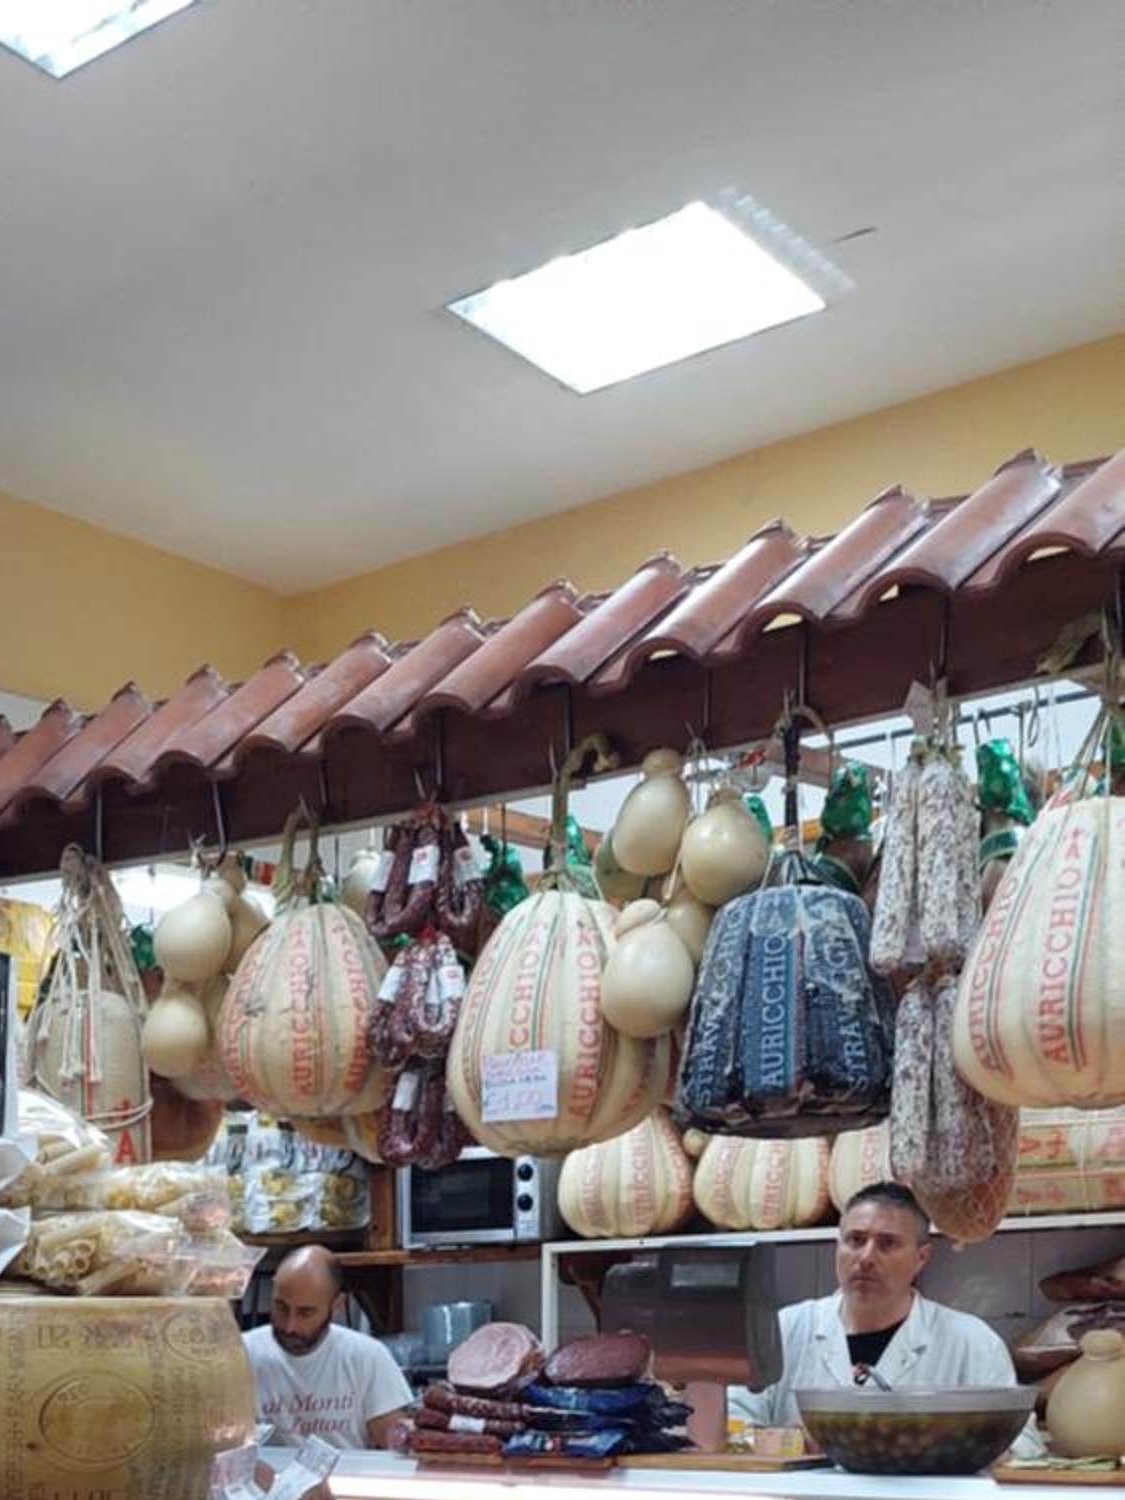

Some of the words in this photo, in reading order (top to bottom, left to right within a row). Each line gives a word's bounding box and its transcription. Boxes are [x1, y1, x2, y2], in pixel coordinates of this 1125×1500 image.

[567, 951, 602, 1119] AURICCHIO
[762, 936, 786, 1088] AURICCHIO
[1035, 867, 1084, 1064] AURICCHIO
